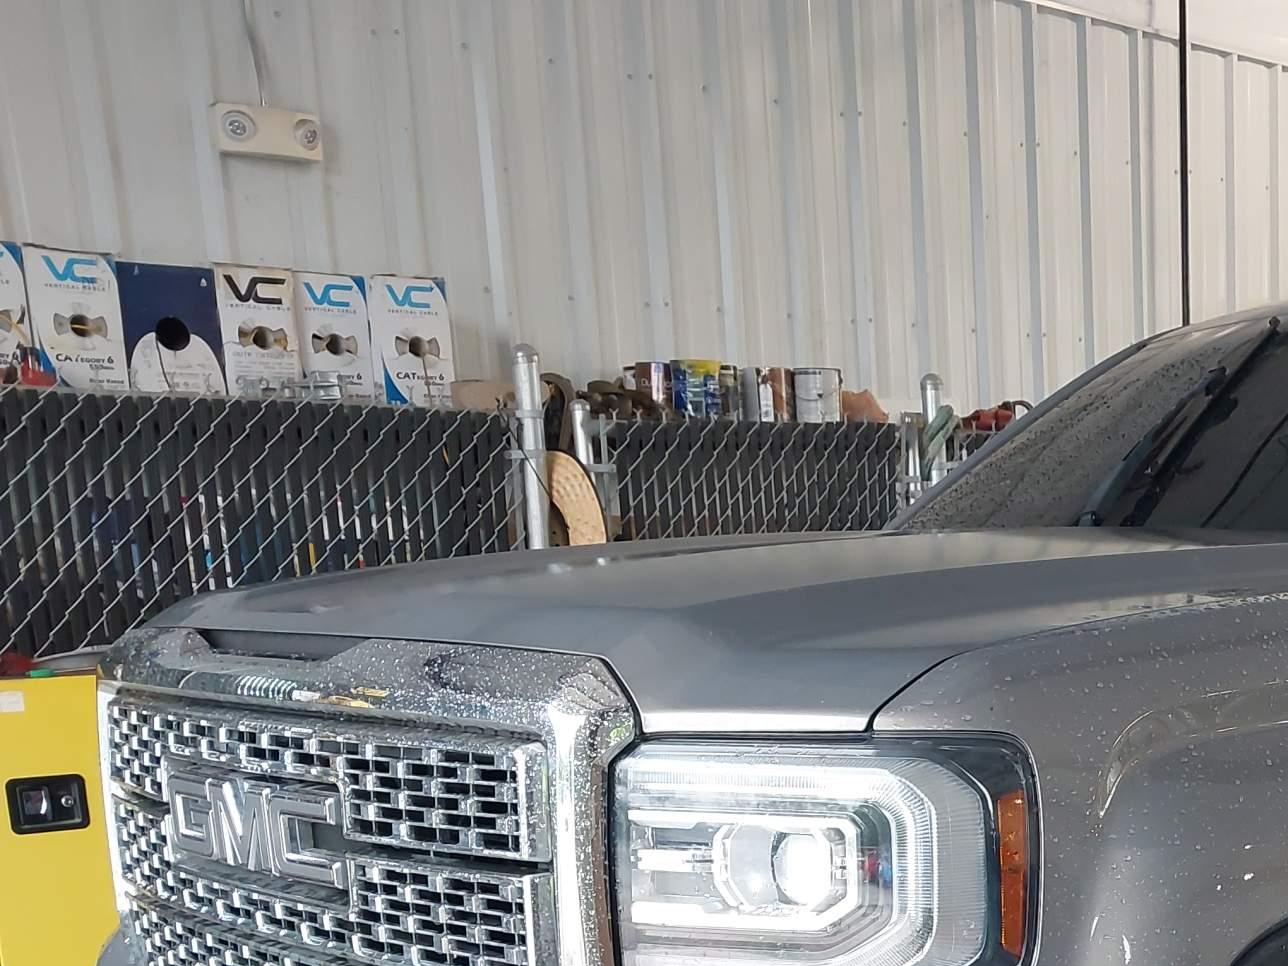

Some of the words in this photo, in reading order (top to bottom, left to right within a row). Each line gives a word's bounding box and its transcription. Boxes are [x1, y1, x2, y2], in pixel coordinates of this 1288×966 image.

[41, 255, 97, 284] VC
[223, 274, 286, 305] VC
[303, 281, 353, 307] VC
[385, 284, 434, 308] VC
[107, 356, 114, 364] 6
[166, 768, 346, 889] GMC
